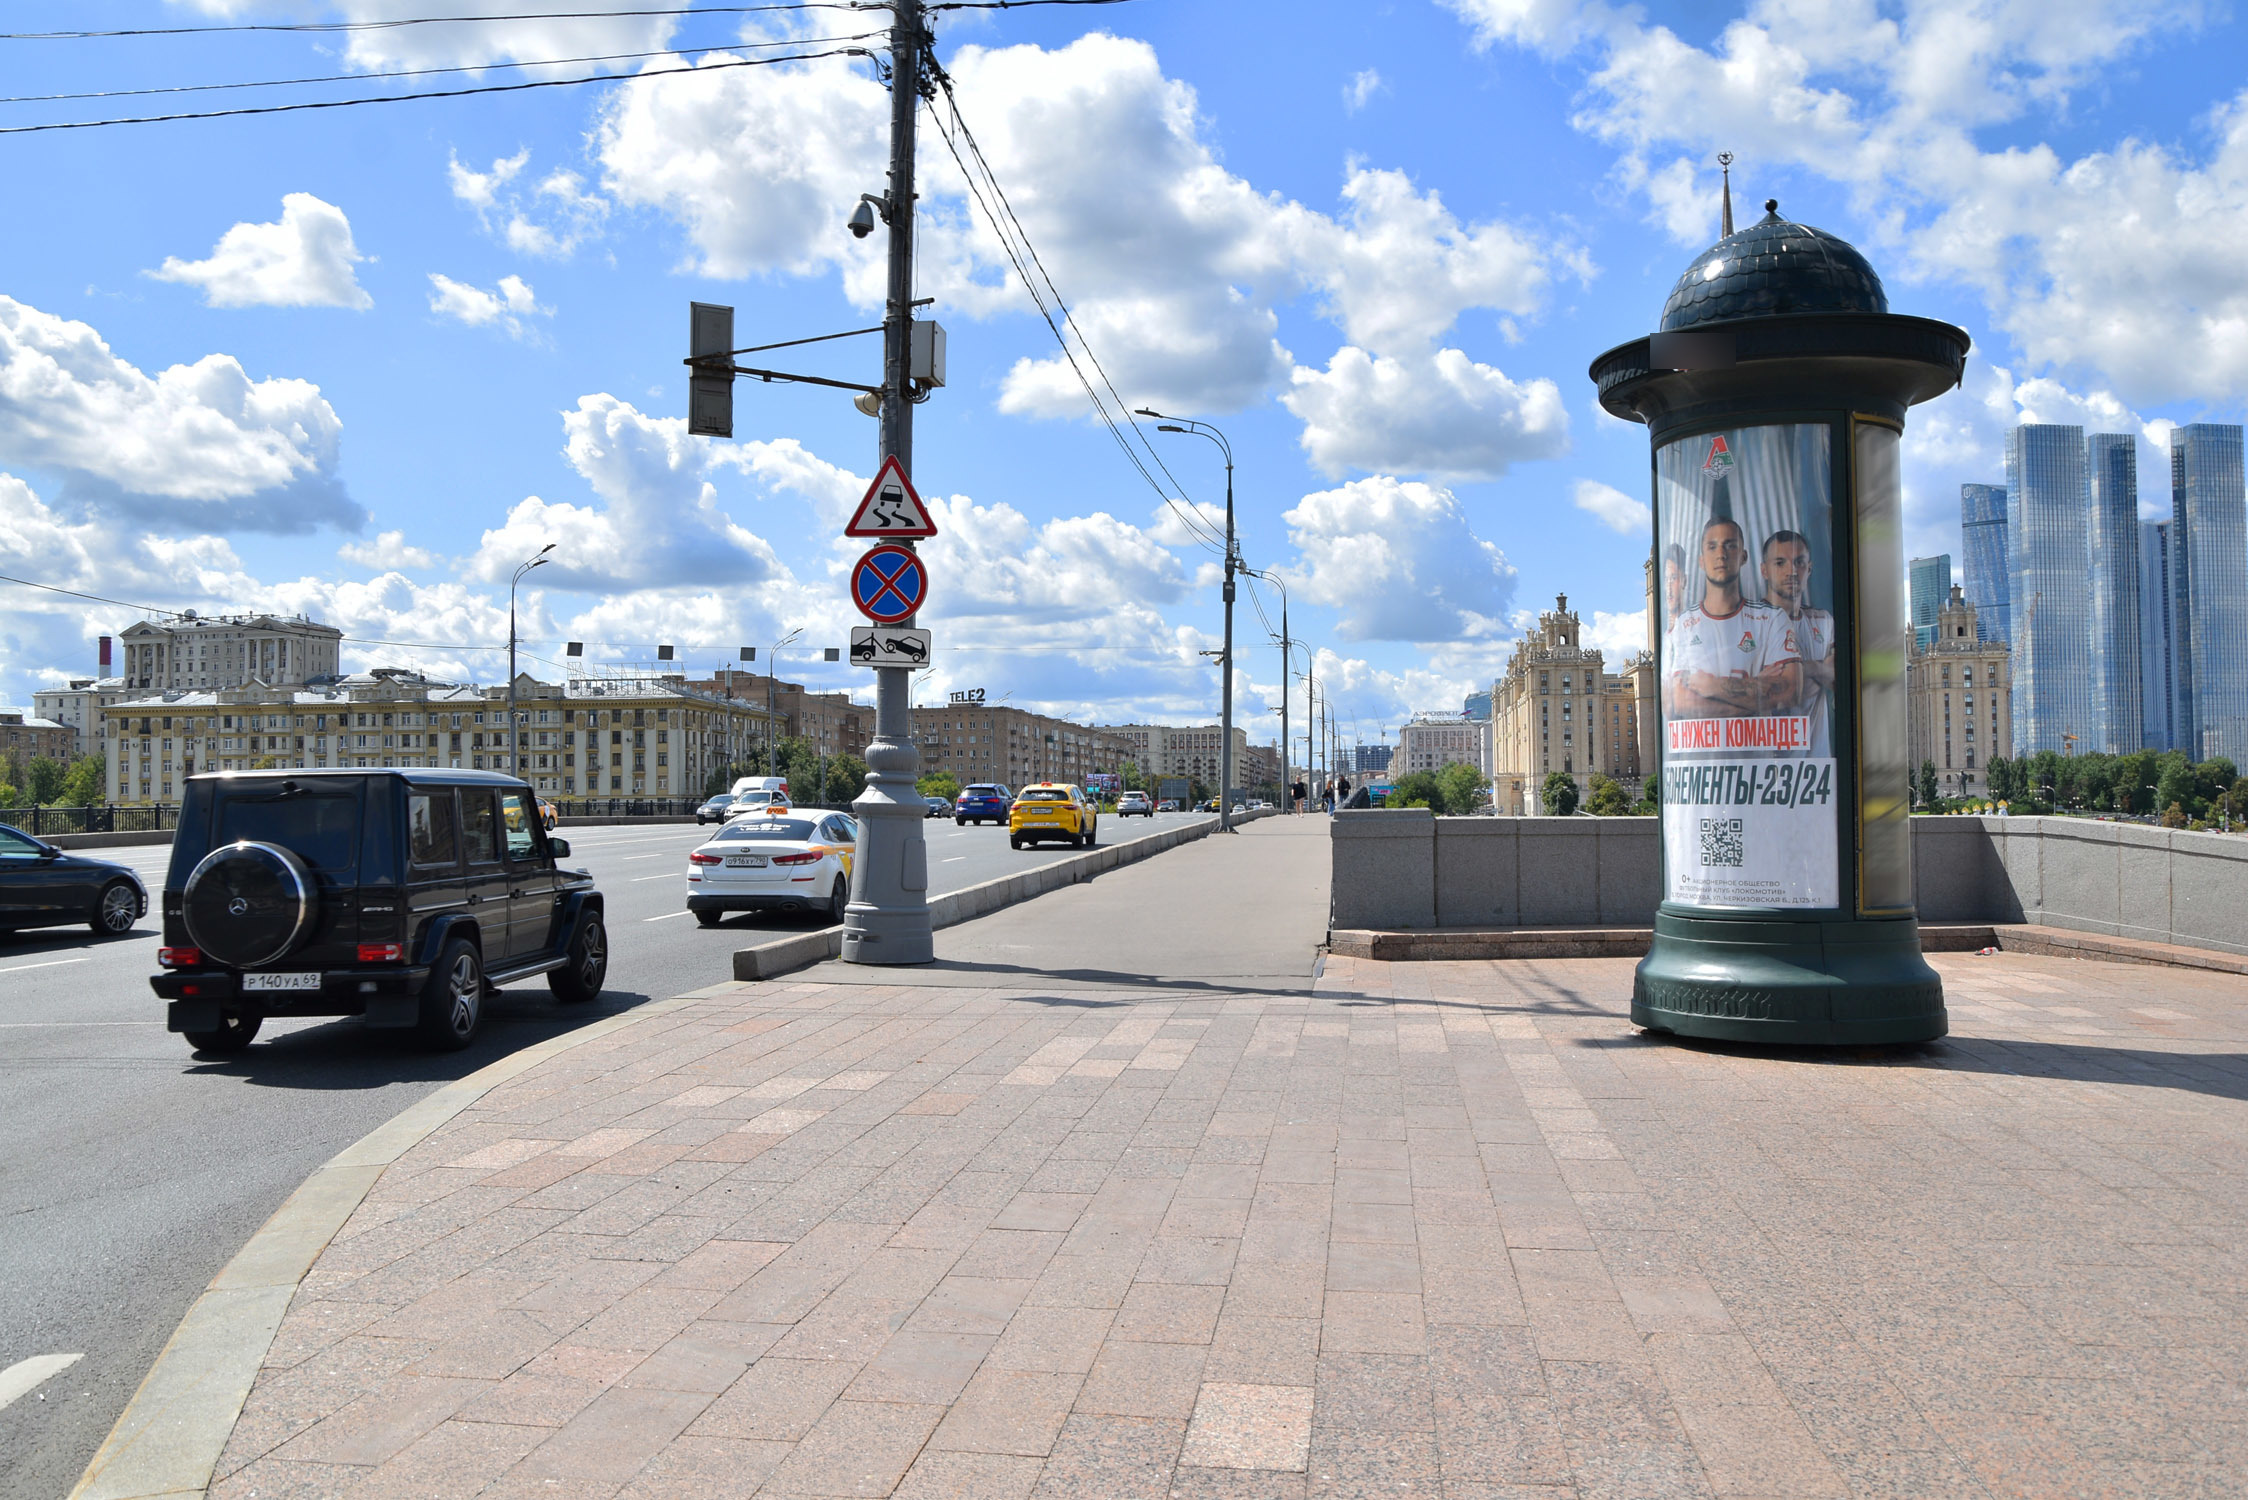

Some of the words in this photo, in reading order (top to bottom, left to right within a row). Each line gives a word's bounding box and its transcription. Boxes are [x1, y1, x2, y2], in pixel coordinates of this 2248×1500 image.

[949, 687, 986, 703] TELE2
[1669, 723, 1679, 749] ТЫ
[1681, 719, 1720, 749] НУЖЕН
[1726, 718, 1807, 750] КОМАНДЕ!
[1664, 761, 1831, 809] БОНЕМЕНТЫ-23/24
